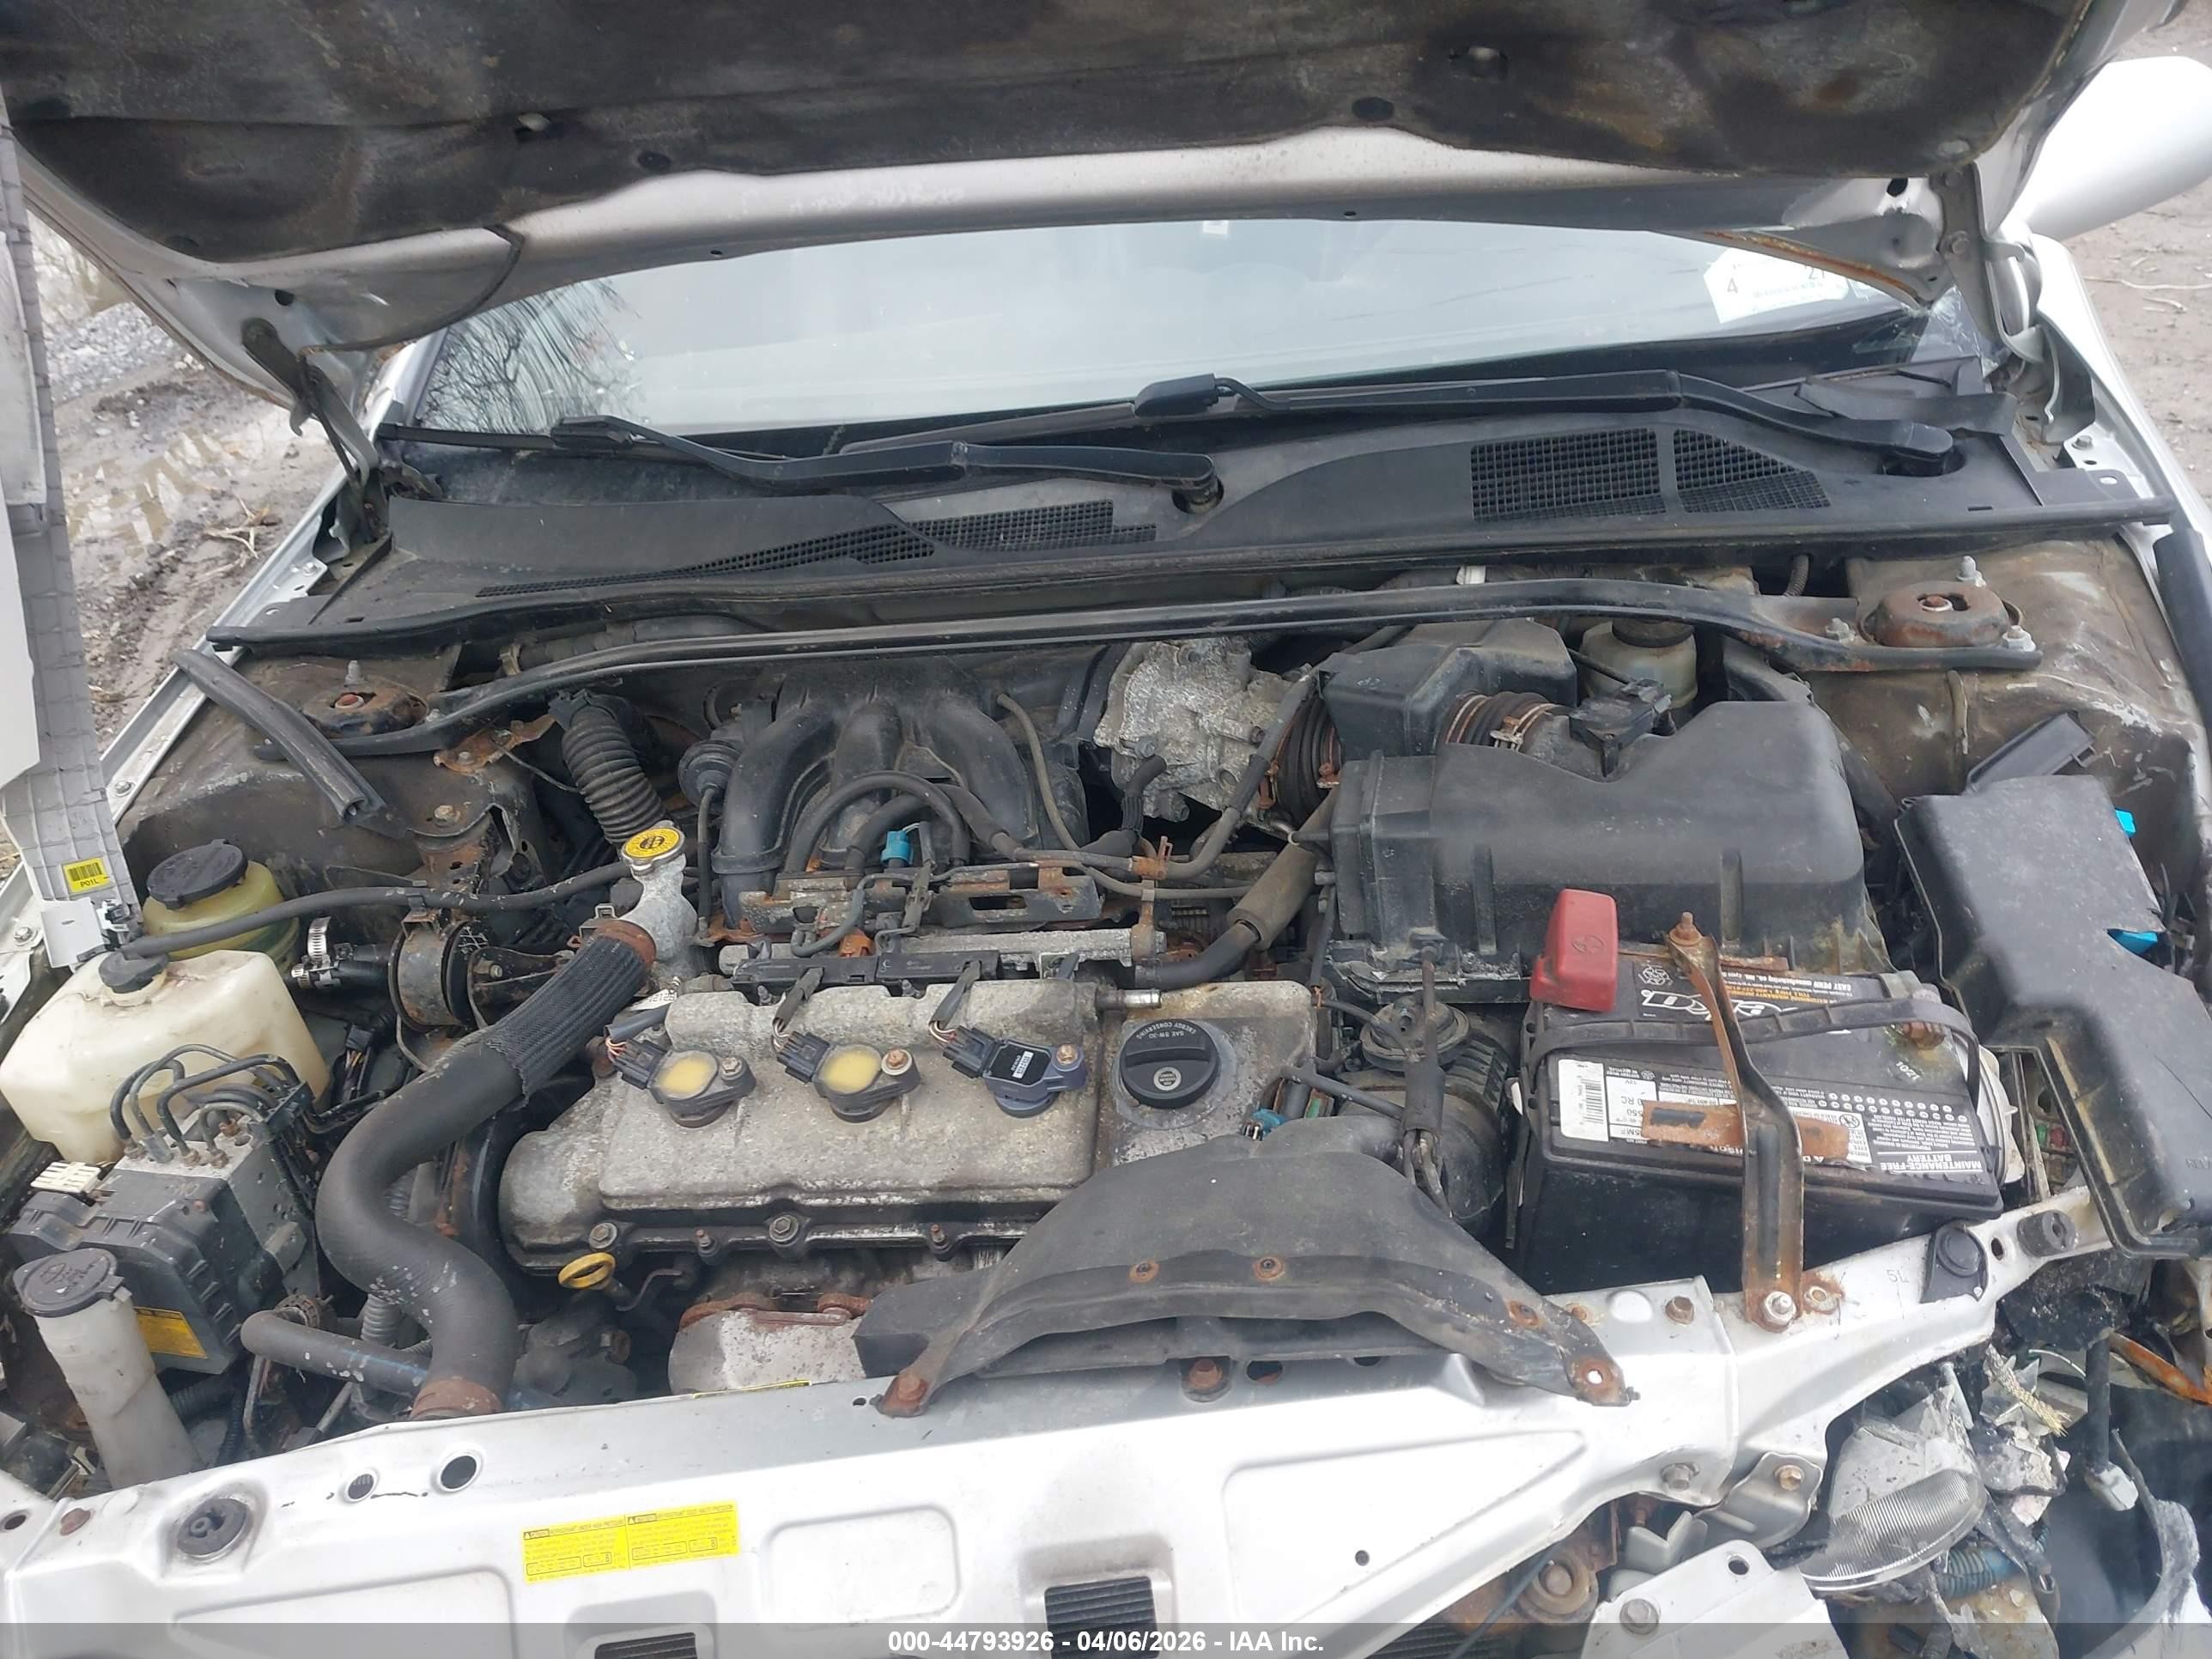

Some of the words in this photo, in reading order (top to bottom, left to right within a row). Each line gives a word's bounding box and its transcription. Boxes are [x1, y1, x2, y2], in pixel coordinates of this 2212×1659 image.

[1620, 1096, 1635, 1104] RC
[1621, 1127, 1642, 1136] 5MF
[1907, 1154, 1952, 1163] BATTERY
[1880, 1161, 1982, 1171] MAINTENANCE-FREE
